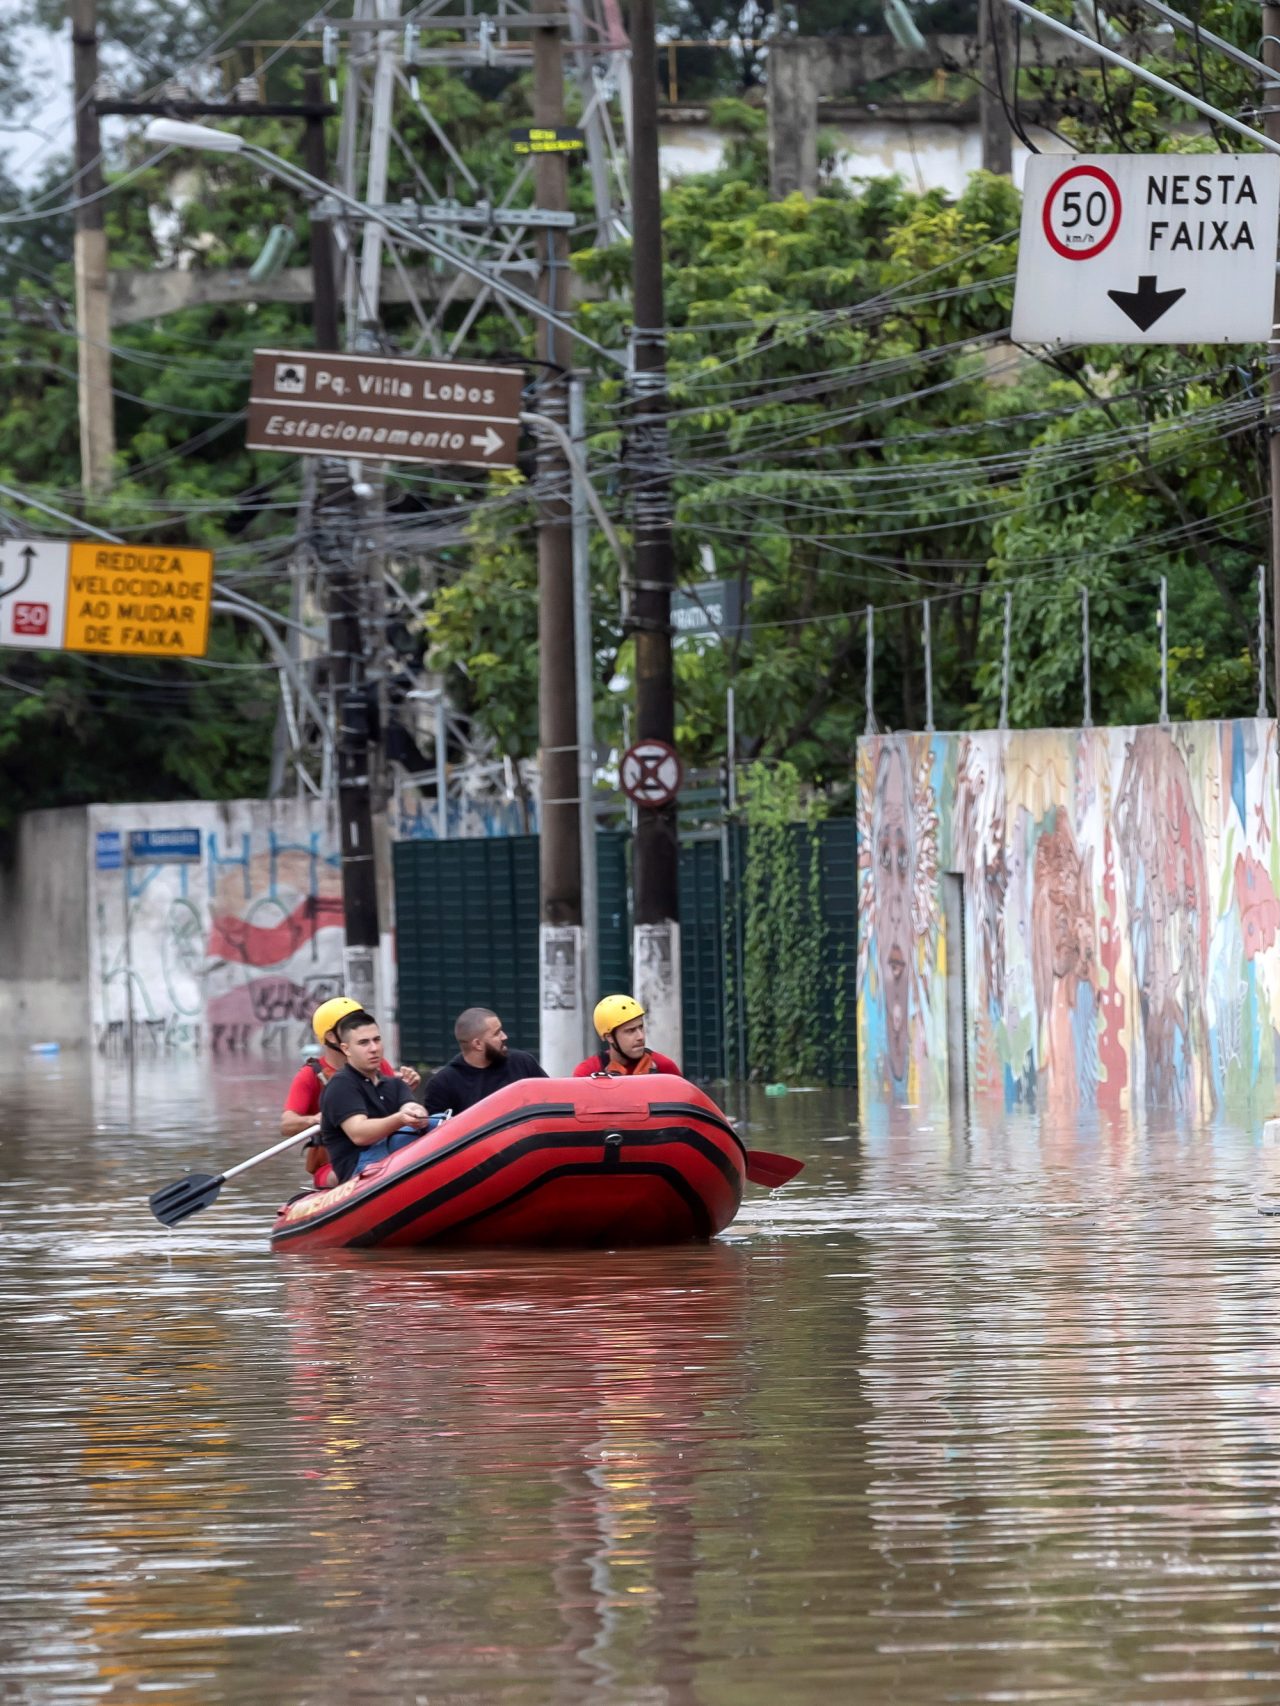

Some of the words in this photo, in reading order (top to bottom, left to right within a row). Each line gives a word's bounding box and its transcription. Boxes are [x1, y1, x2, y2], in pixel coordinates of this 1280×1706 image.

[1147, 175, 1258, 206] NESTA
[1061, 191, 1107, 228] 50
[1065, 233, 1095, 243] km/h
[1149, 220, 1255, 251] FAIXA
[315, 370, 350, 396] Pq.
[357, 374, 413, 397] Villa
[422, 379, 496, 405] Lobos
[264, 415, 465, 450] Estacionamento
[95, 551, 184, 574] REDUZA
[72, 575, 205, 601] VELOCIDADE
[15, 605, 47, 626] 50
[79, 601, 111, 620] AO
[116, 603, 196, 624] MUDAR
[83, 625, 112, 645] DE
[119, 627, 185, 648] FAIXA
